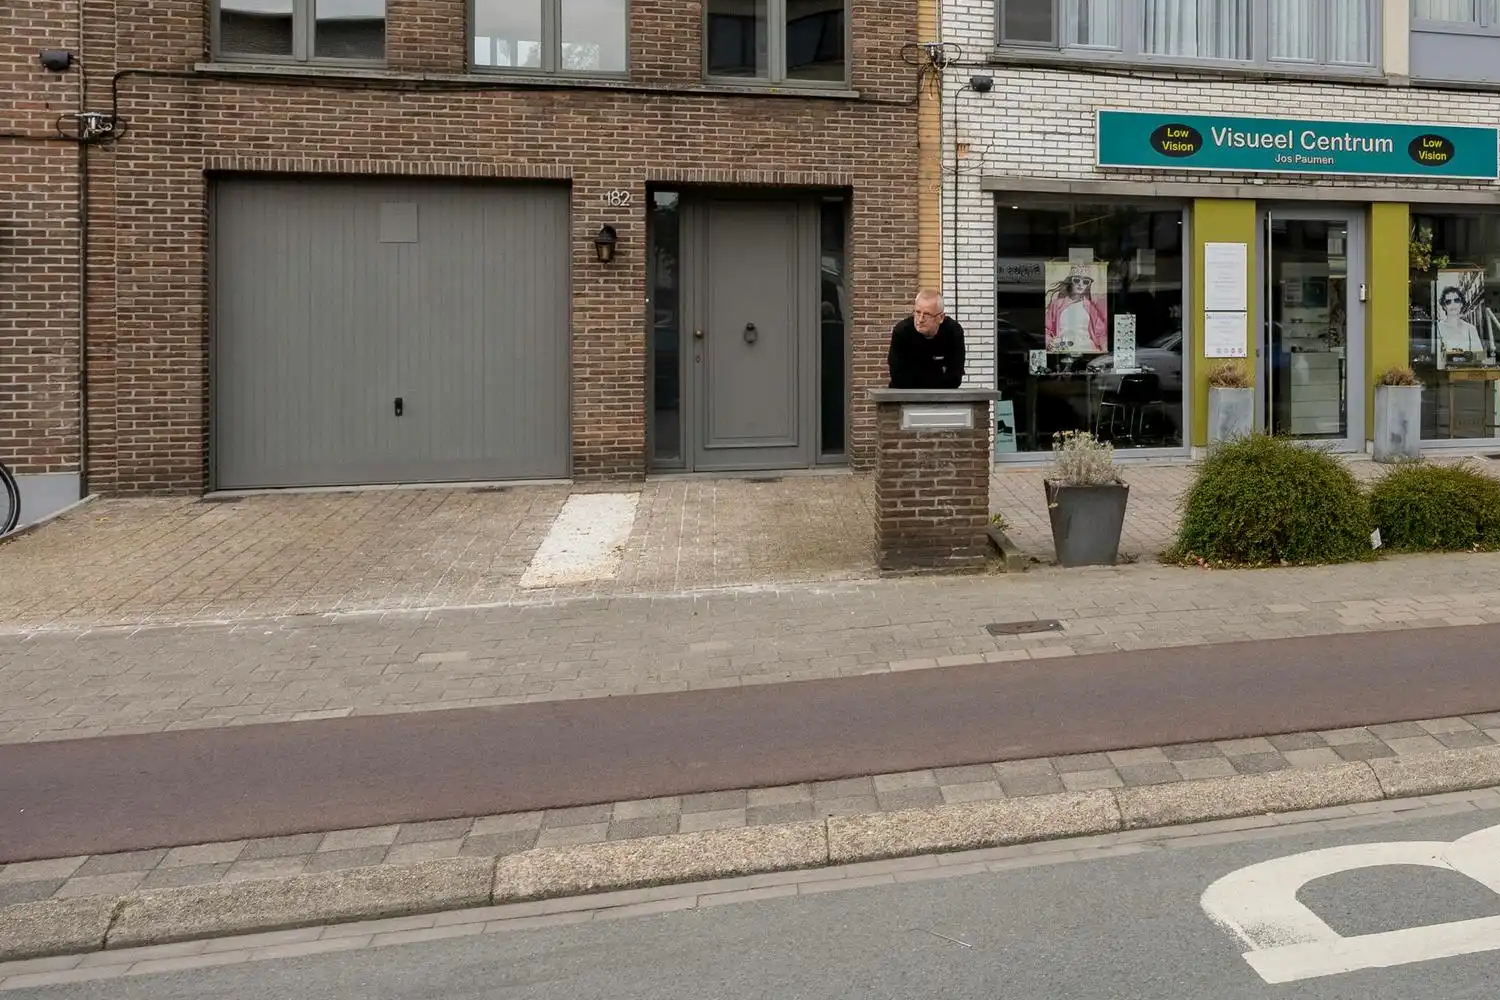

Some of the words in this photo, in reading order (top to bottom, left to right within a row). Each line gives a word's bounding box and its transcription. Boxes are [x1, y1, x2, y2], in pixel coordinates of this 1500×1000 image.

[1167, 128, 1189, 138] Low
[1211, 127, 1293, 149] Visueel
[1300, 131, 1394, 152] Centrum
[1423, 139, 1443, 148] Low
[1161, 141, 1194, 151] Vision
[1274, 154, 1292, 163] Jos
[1295, 154, 1335, 164] Paumen
[1418, 151, 1447, 160] Vision
[606, 190, 630, 206] 182
